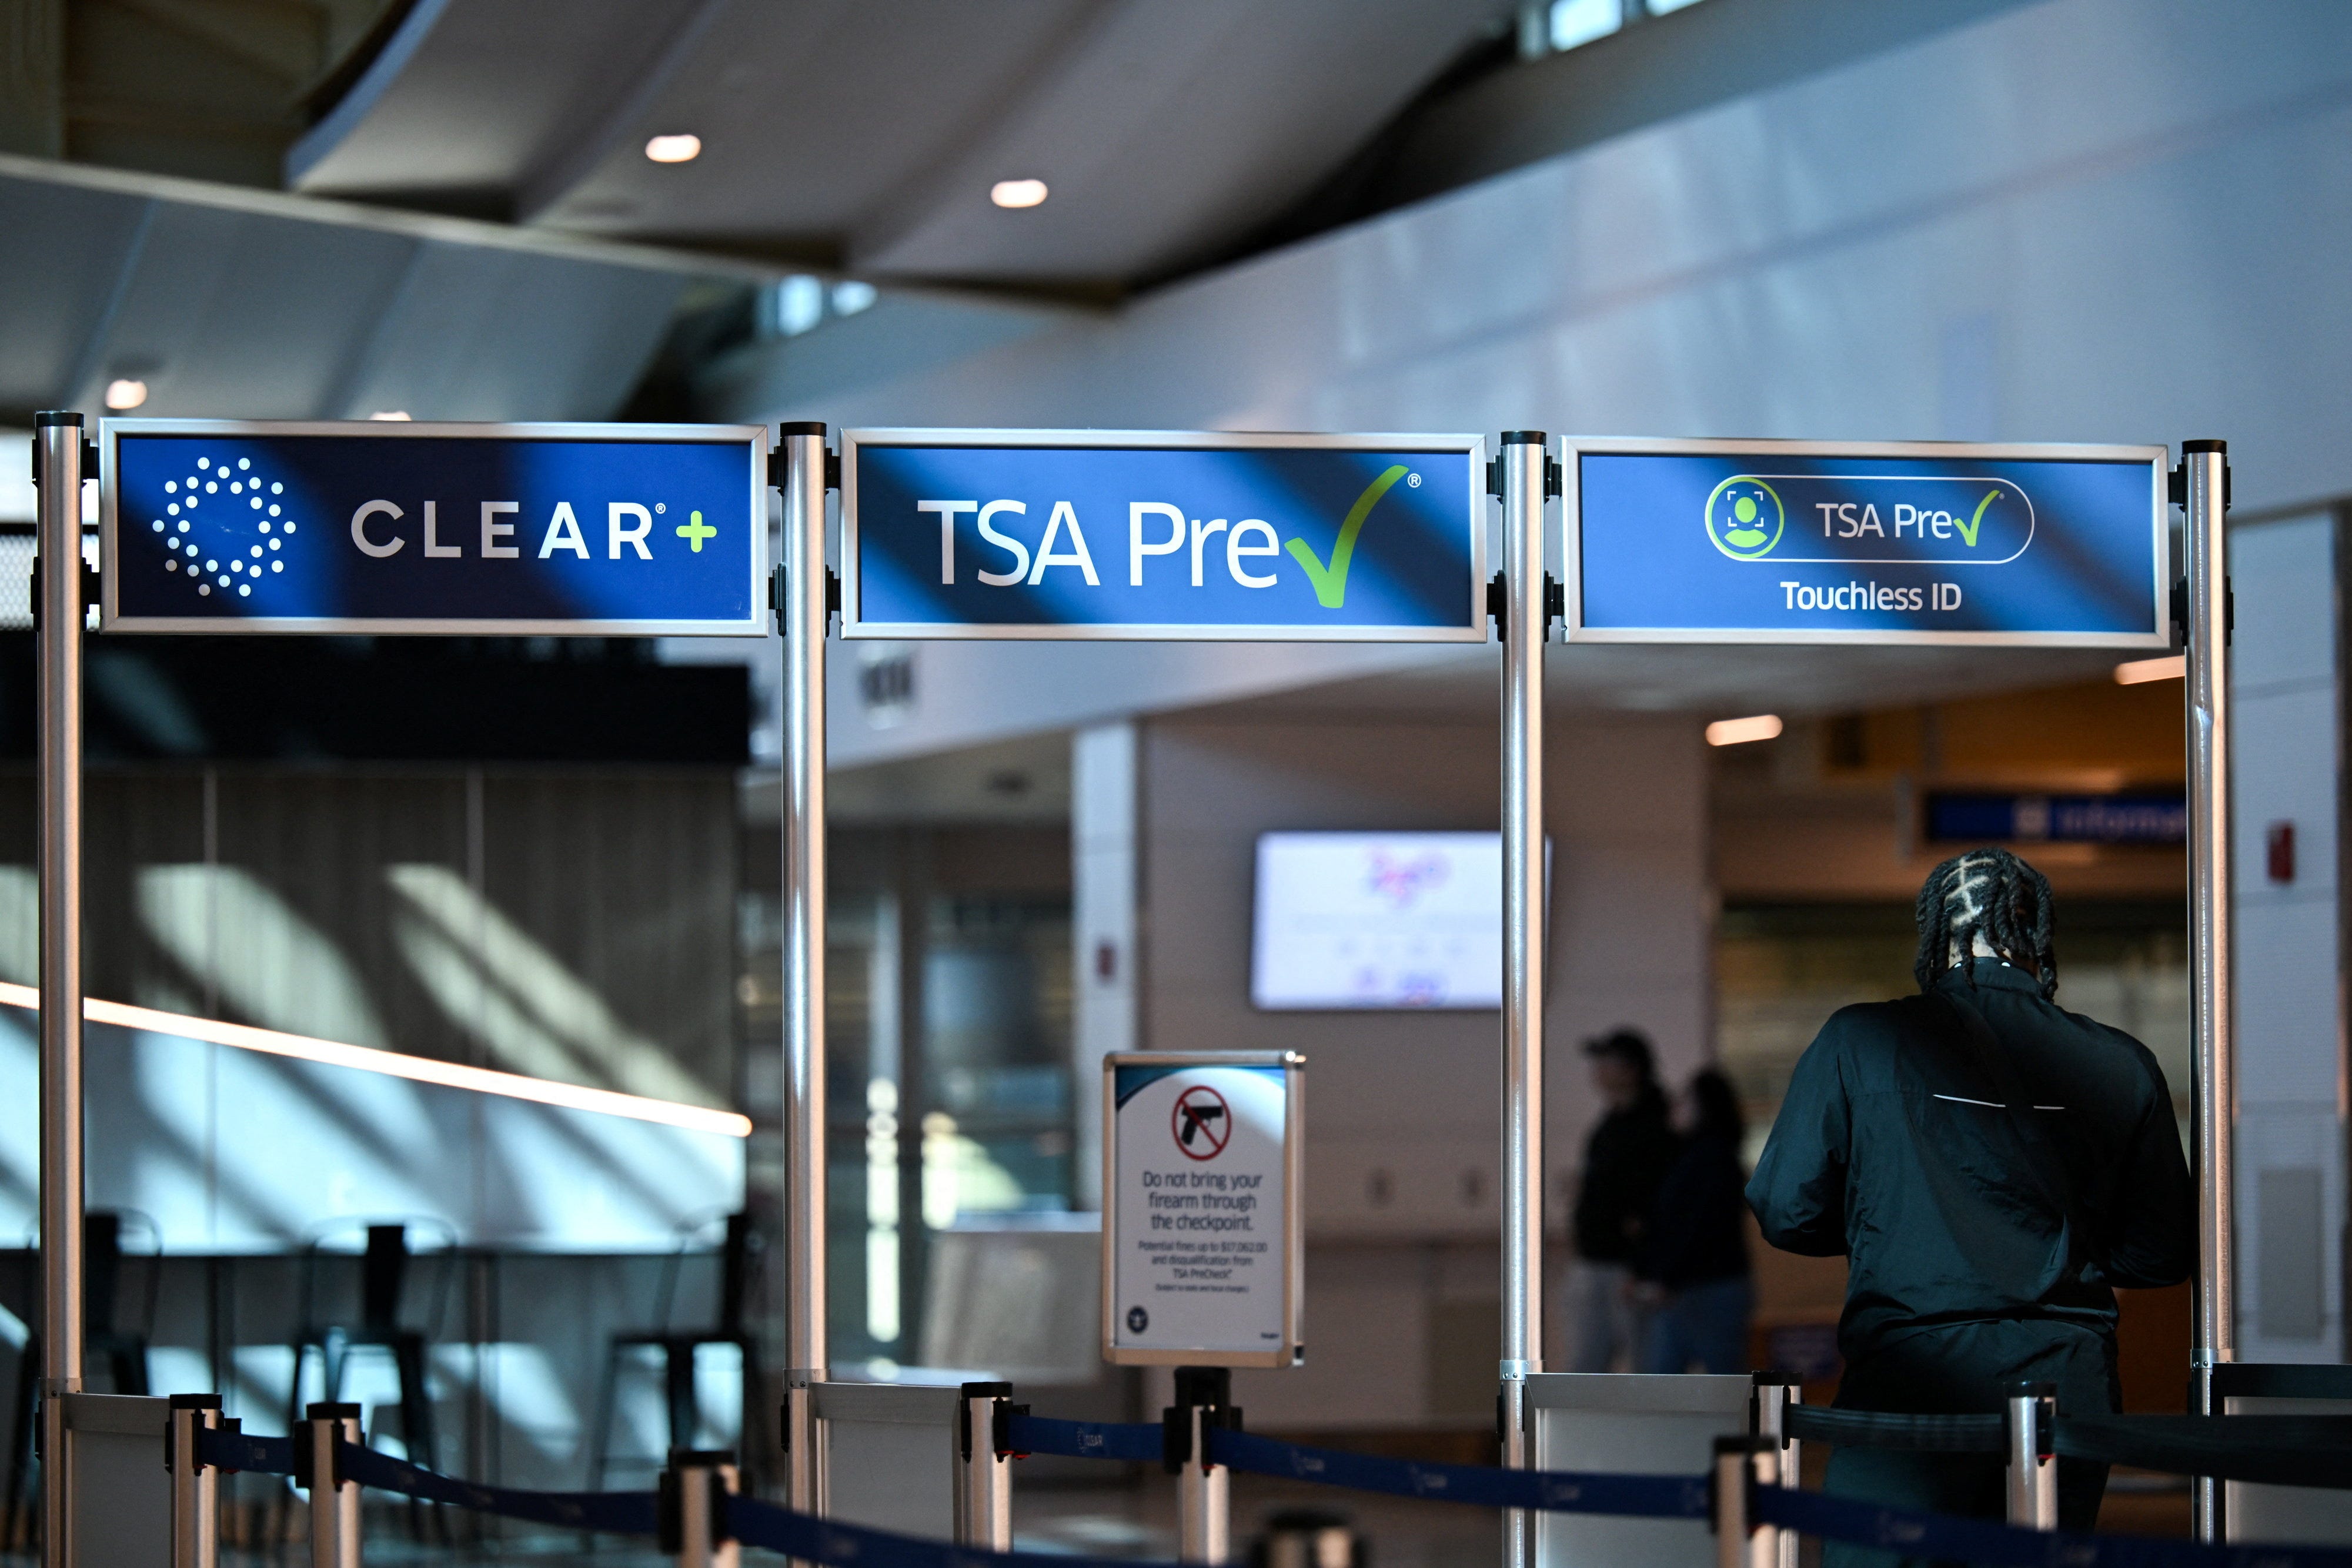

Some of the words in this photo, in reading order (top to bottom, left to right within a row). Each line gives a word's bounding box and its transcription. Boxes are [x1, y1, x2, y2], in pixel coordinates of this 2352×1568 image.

[1816, 503, 1885, 537] TSA
[917, 499, 1101, 586] TSA
[1780, 581, 1923, 610] Touchless
[1932, 583, 1962, 610] ID
[1142, 1170, 1162, 1188] Do
[1164, 1172, 1187, 1188] not
[1190, 1171, 1227, 1191] bring
[1230, 1174, 1263, 1191] your
[1148, 1191, 1199, 1209] firearm
[1201, 1192, 1257, 1212] through
[1151, 1213, 1174, 1229] the
[1176, 1213, 1254, 1232] checkpoint.
[1138, 1240, 1174, 1251] Potential
[1175, 1241, 1196, 1252] fines
[1197, 1242, 1209, 1253] up
[1210, 1241, 1220, 1252] to
[1151, 1255, 1168, 1265] and
[1169, 1254, 1230, 1266] disqualification
[1232, 1255, 1254, 1266] from
[1172, 1268, 1188, 1279] TSA
